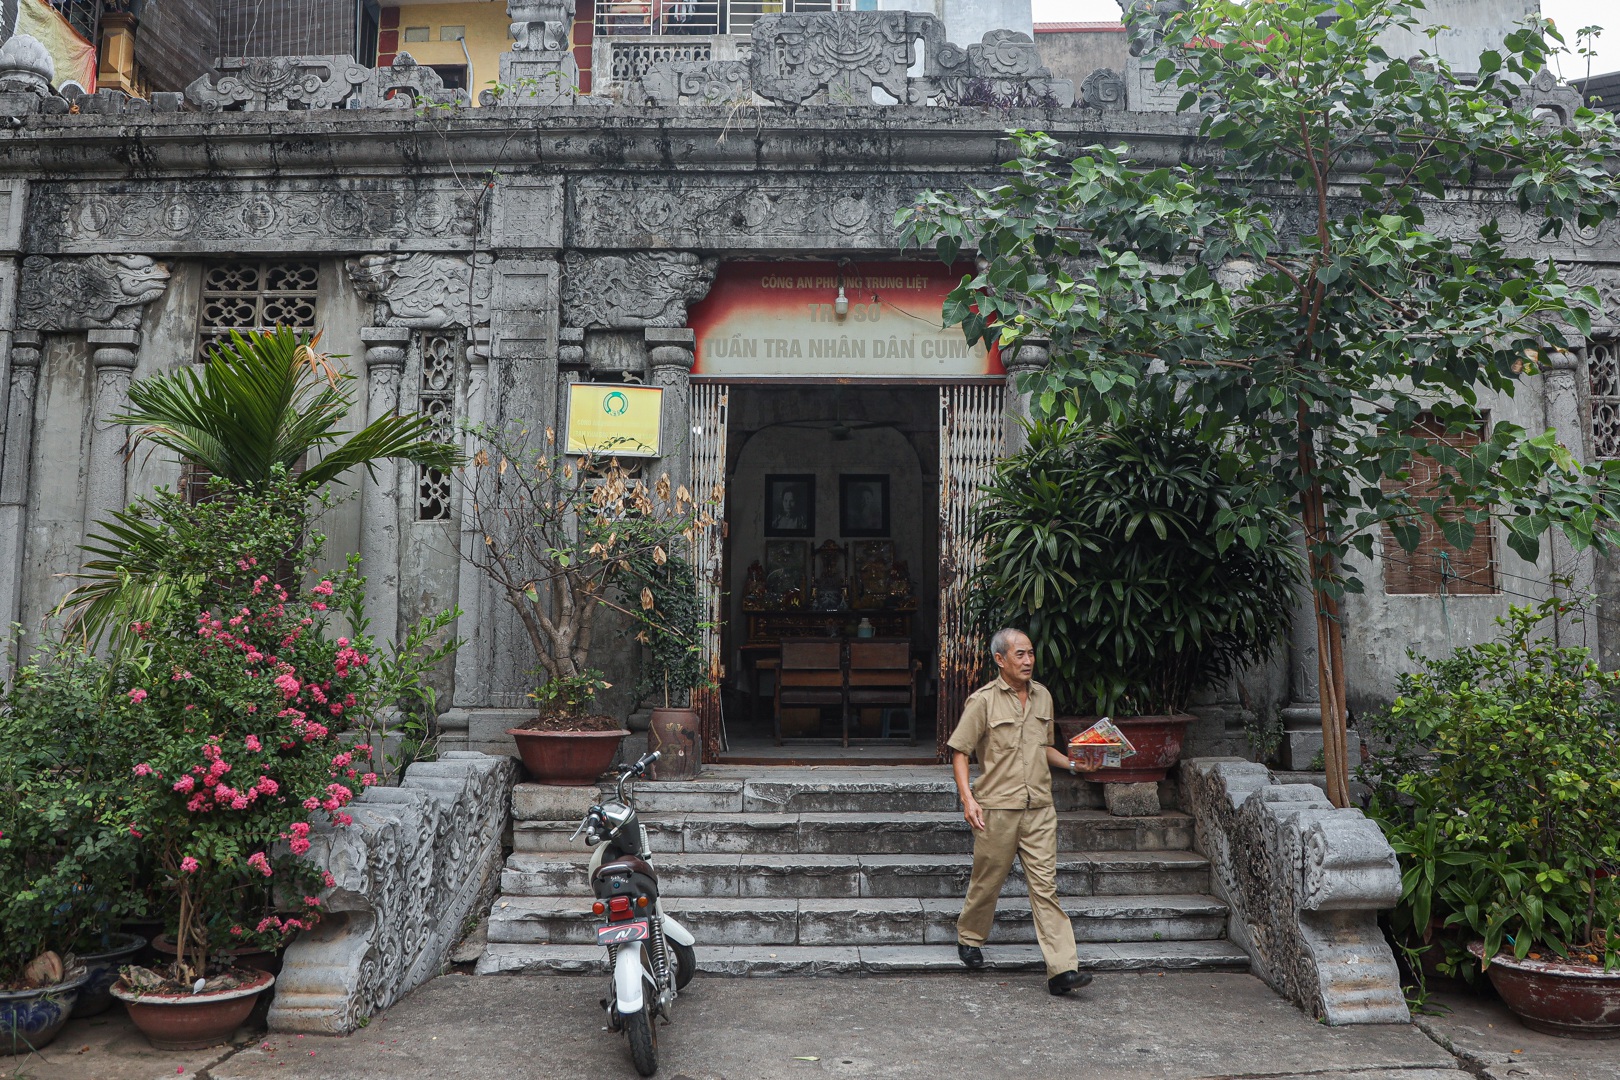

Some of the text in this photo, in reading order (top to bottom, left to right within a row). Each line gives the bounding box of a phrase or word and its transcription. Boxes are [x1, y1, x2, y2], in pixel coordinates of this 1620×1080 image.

[761, 273, 793, 289] CÔNG
[797, 276, 813, 289] AN
[865, 276, 903, 289] TRUNG
[906, 274, 929, 292] LIỆT
[764, 339, 802, 358] TRA
[808, 335, 866, 358] NHÂN
[873, 335, 915, 358] DÂN
[921, 339, 967, 363] CỤM
